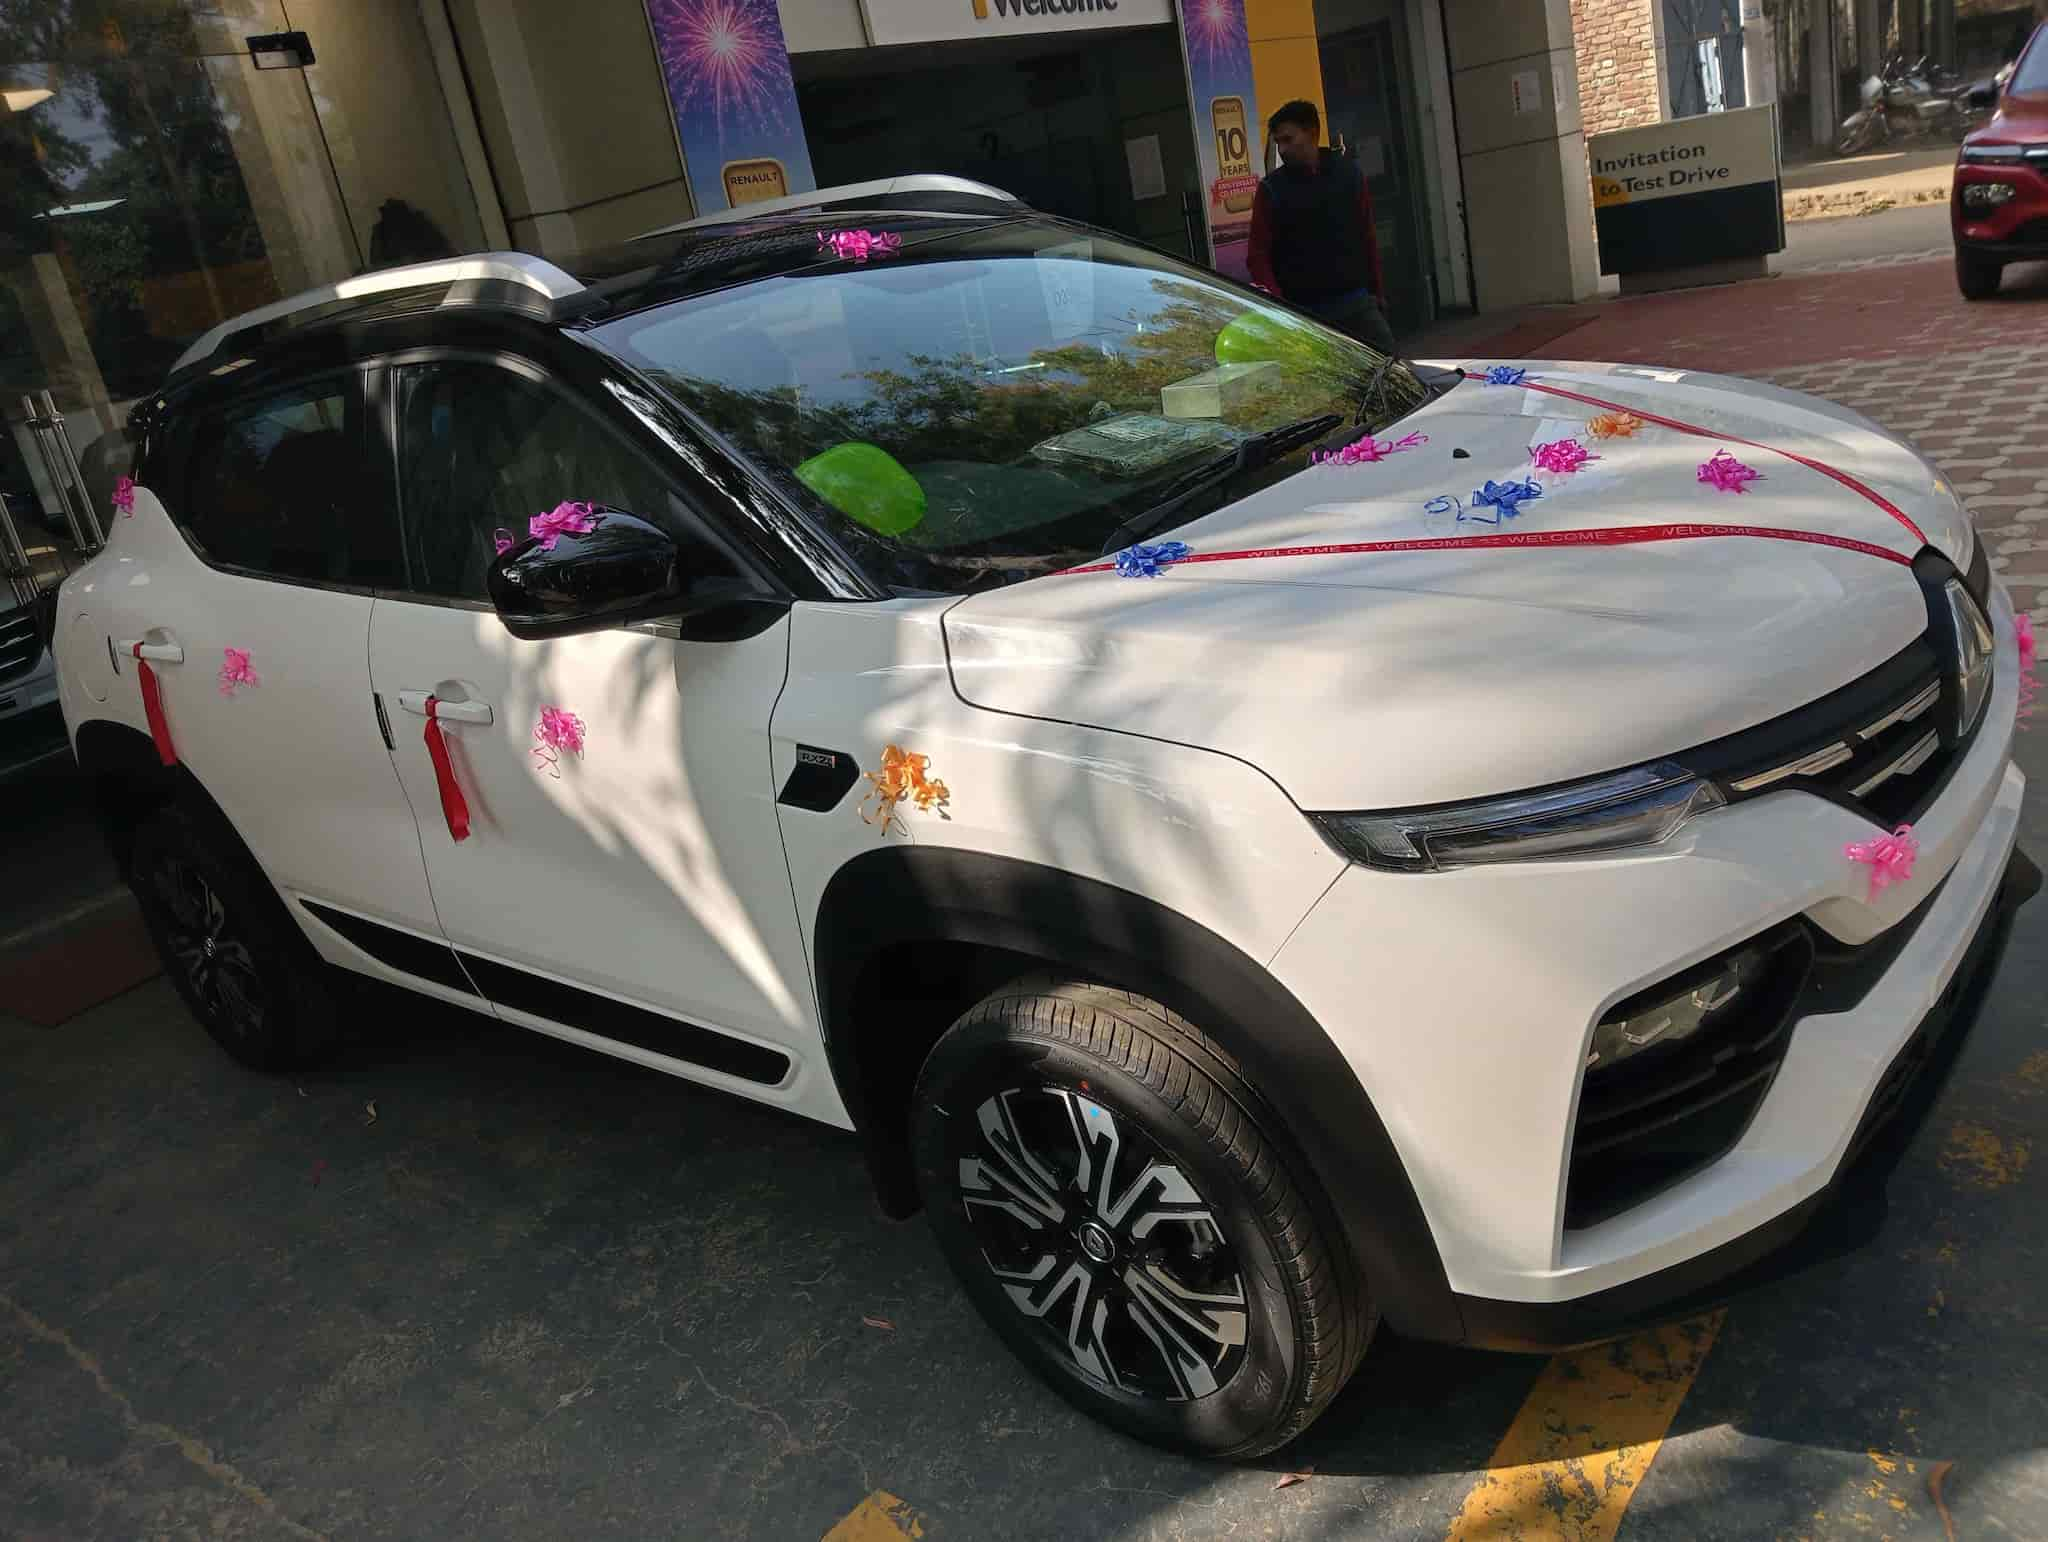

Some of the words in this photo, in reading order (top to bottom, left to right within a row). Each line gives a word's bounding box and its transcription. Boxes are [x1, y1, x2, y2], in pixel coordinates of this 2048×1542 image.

[1217, 127, 1247, 161] 10
[1222, 164, 1249, 176] YEARS
[1596, 145, 1705, 173] Invitation
[728, 171, 777, 185] RENAULT
[1600, 182, 1621, 196] to
[1621, 176, 1664, 192] Test
[1669, 166, 1729, 186] Drive
[1247, 546, 1340, 558] WELCOME
[1375, 538, 1472, 550] WELCOME
[1507, 531, 1609, 544] WELCOME
